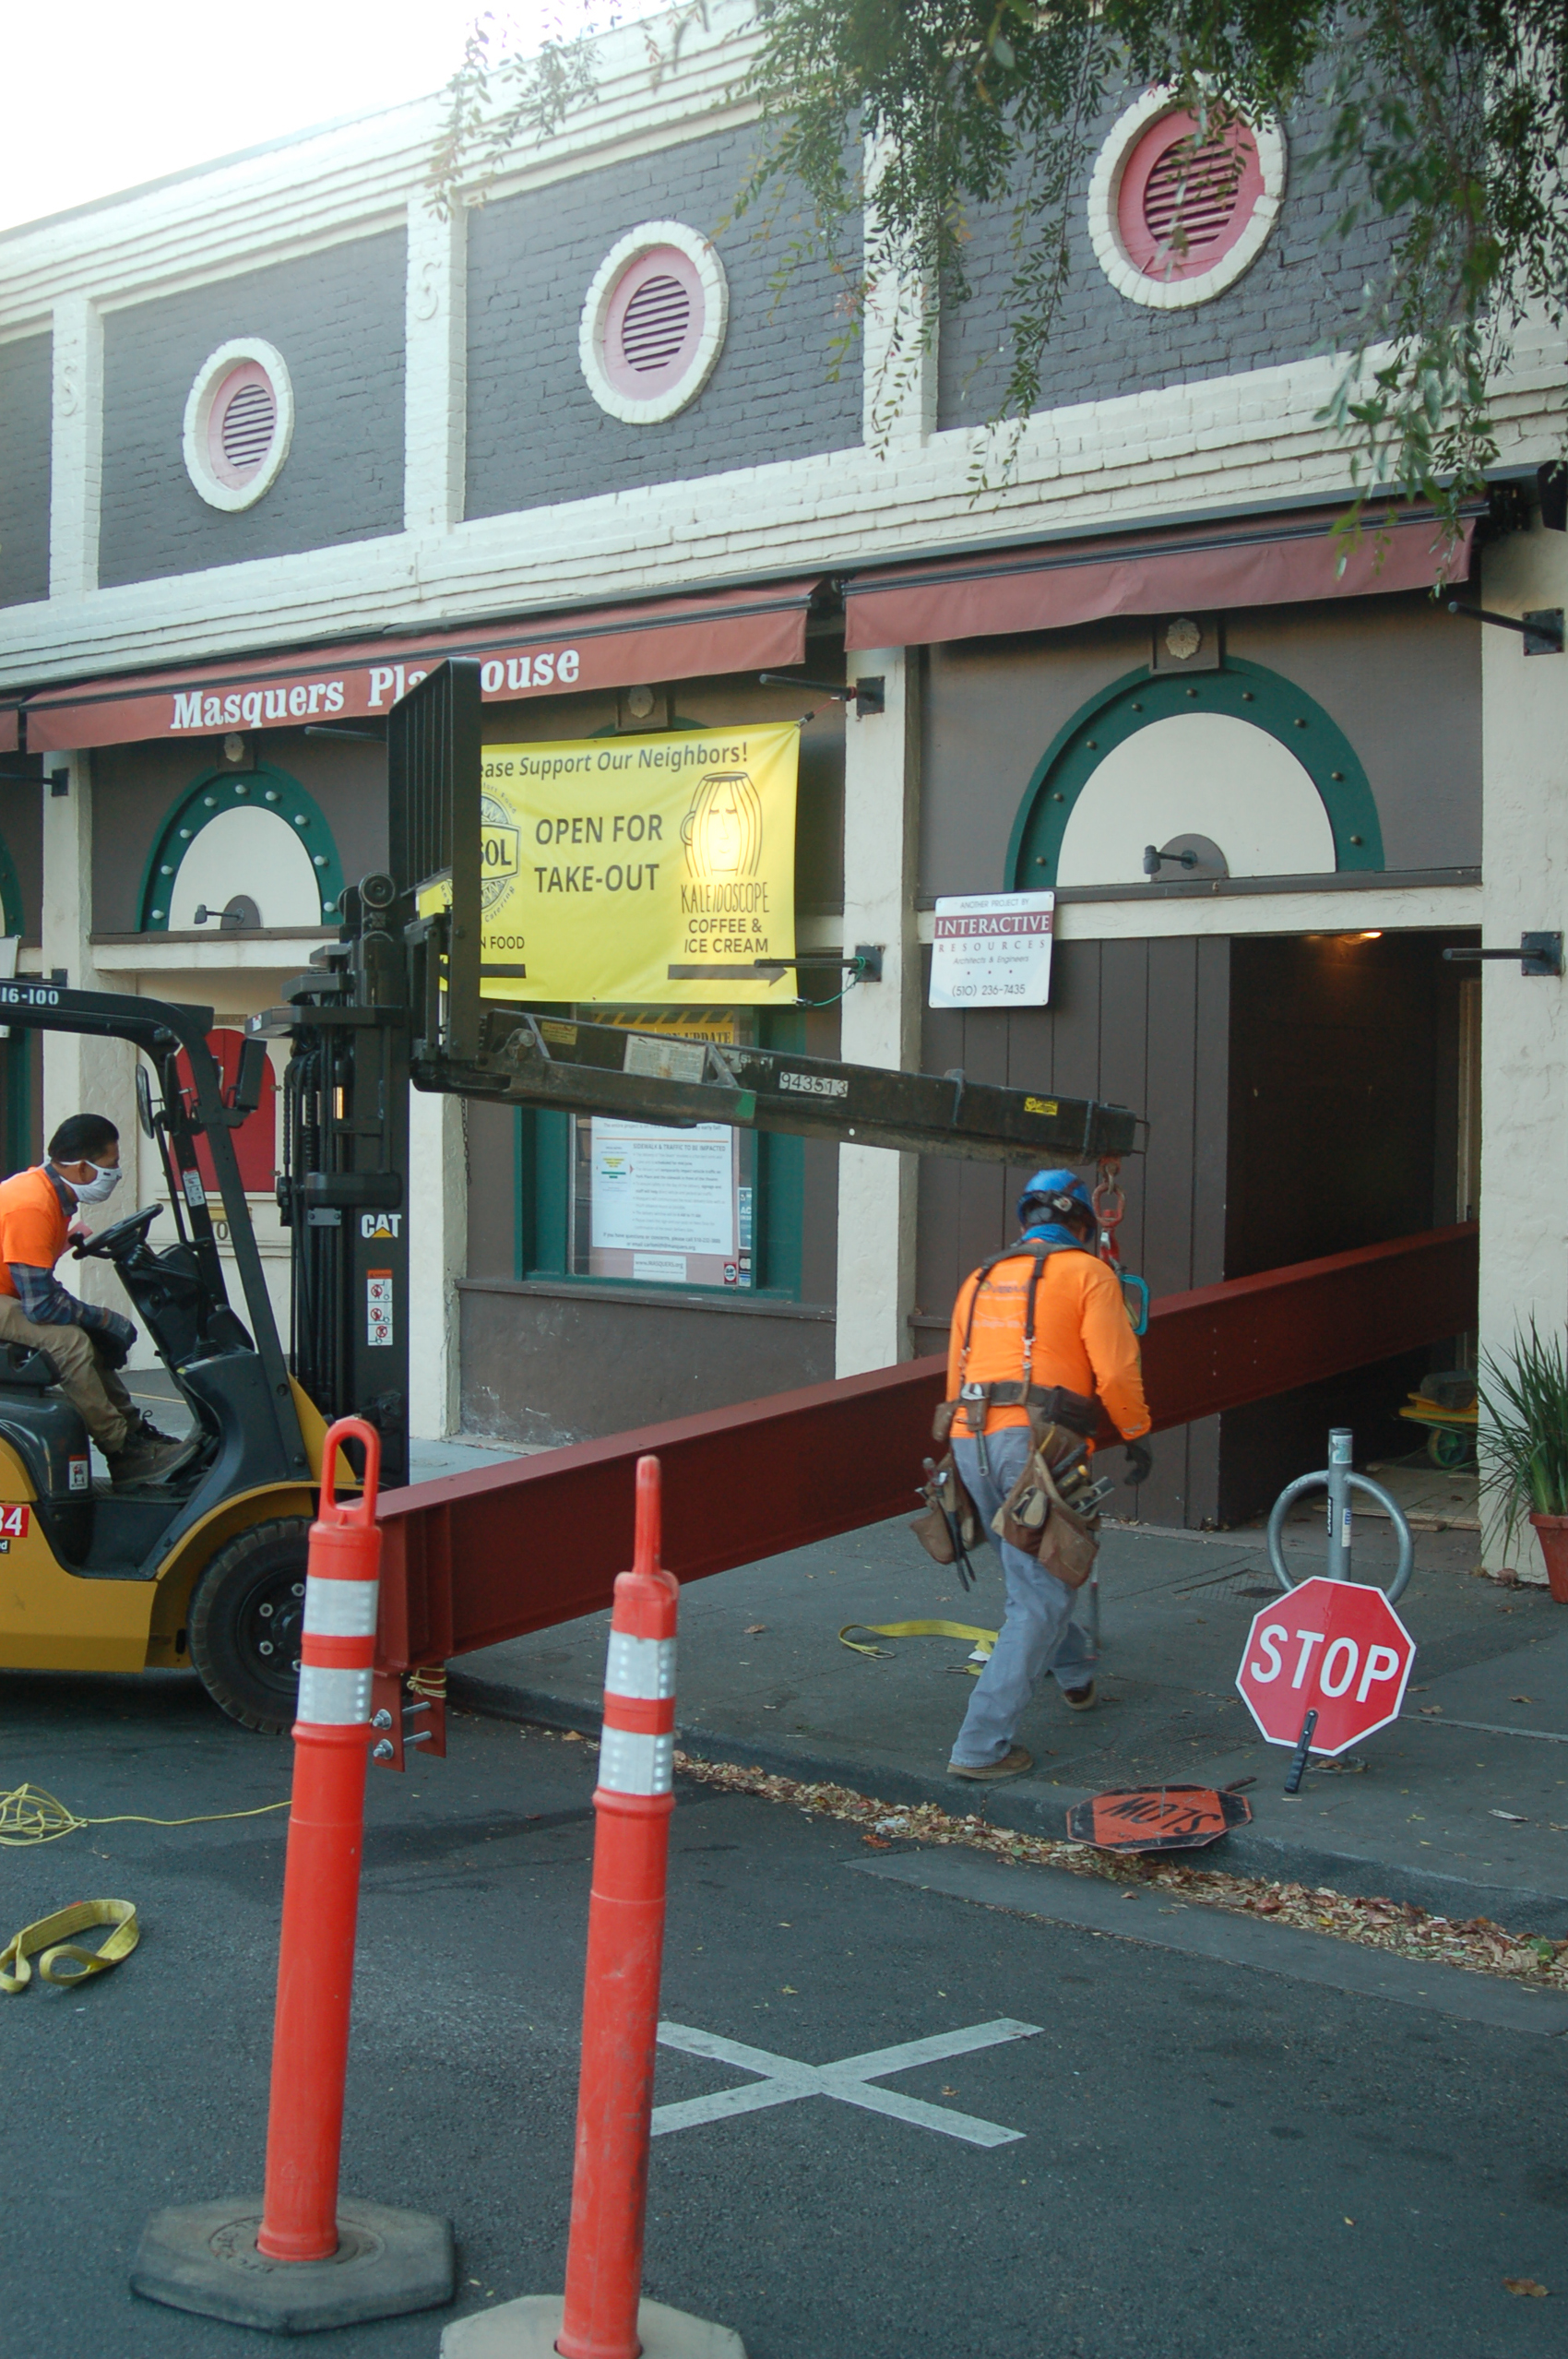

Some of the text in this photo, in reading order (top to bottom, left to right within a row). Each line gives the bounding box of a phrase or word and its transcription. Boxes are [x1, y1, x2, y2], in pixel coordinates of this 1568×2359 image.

[170, 681, 345, 729] Masquers
[519, 754, 591, 780] Support
[597, 751, 634, 771] Our
[638, 742, 748, 772] Neighbors!
[535, 814, 663, 845] OPEN FOR
[534, 864, 660, 893] TAKE-OUT
[681, 881, 770, 913] KALEIDOSCOPE
[960, 900, 989, 909] ANOTHER
[992, 899, 1019, 908] PROJECT
[688, 918, 763, 934] COFFEE &
[937, 915, 1050, 935] INTERACTIVE
[490, 935, 525, 949] FOOD
[684, 938, 768, 953] ICE CREAM
[938, 939, 1045, 953] RESOURCES
[953, 957, 986, 965] Architects
[996, 956, 1029, 965] Engineers
[952, 983, 1026, 997] (510) 236-7435
[781, 1073, 848, 1096] 943513
[361, 1214, 402, 1238] CAT
[1251, 1624, 1399, 1703] STOP
[1099, 1796, 1221, 1835] SLOW
